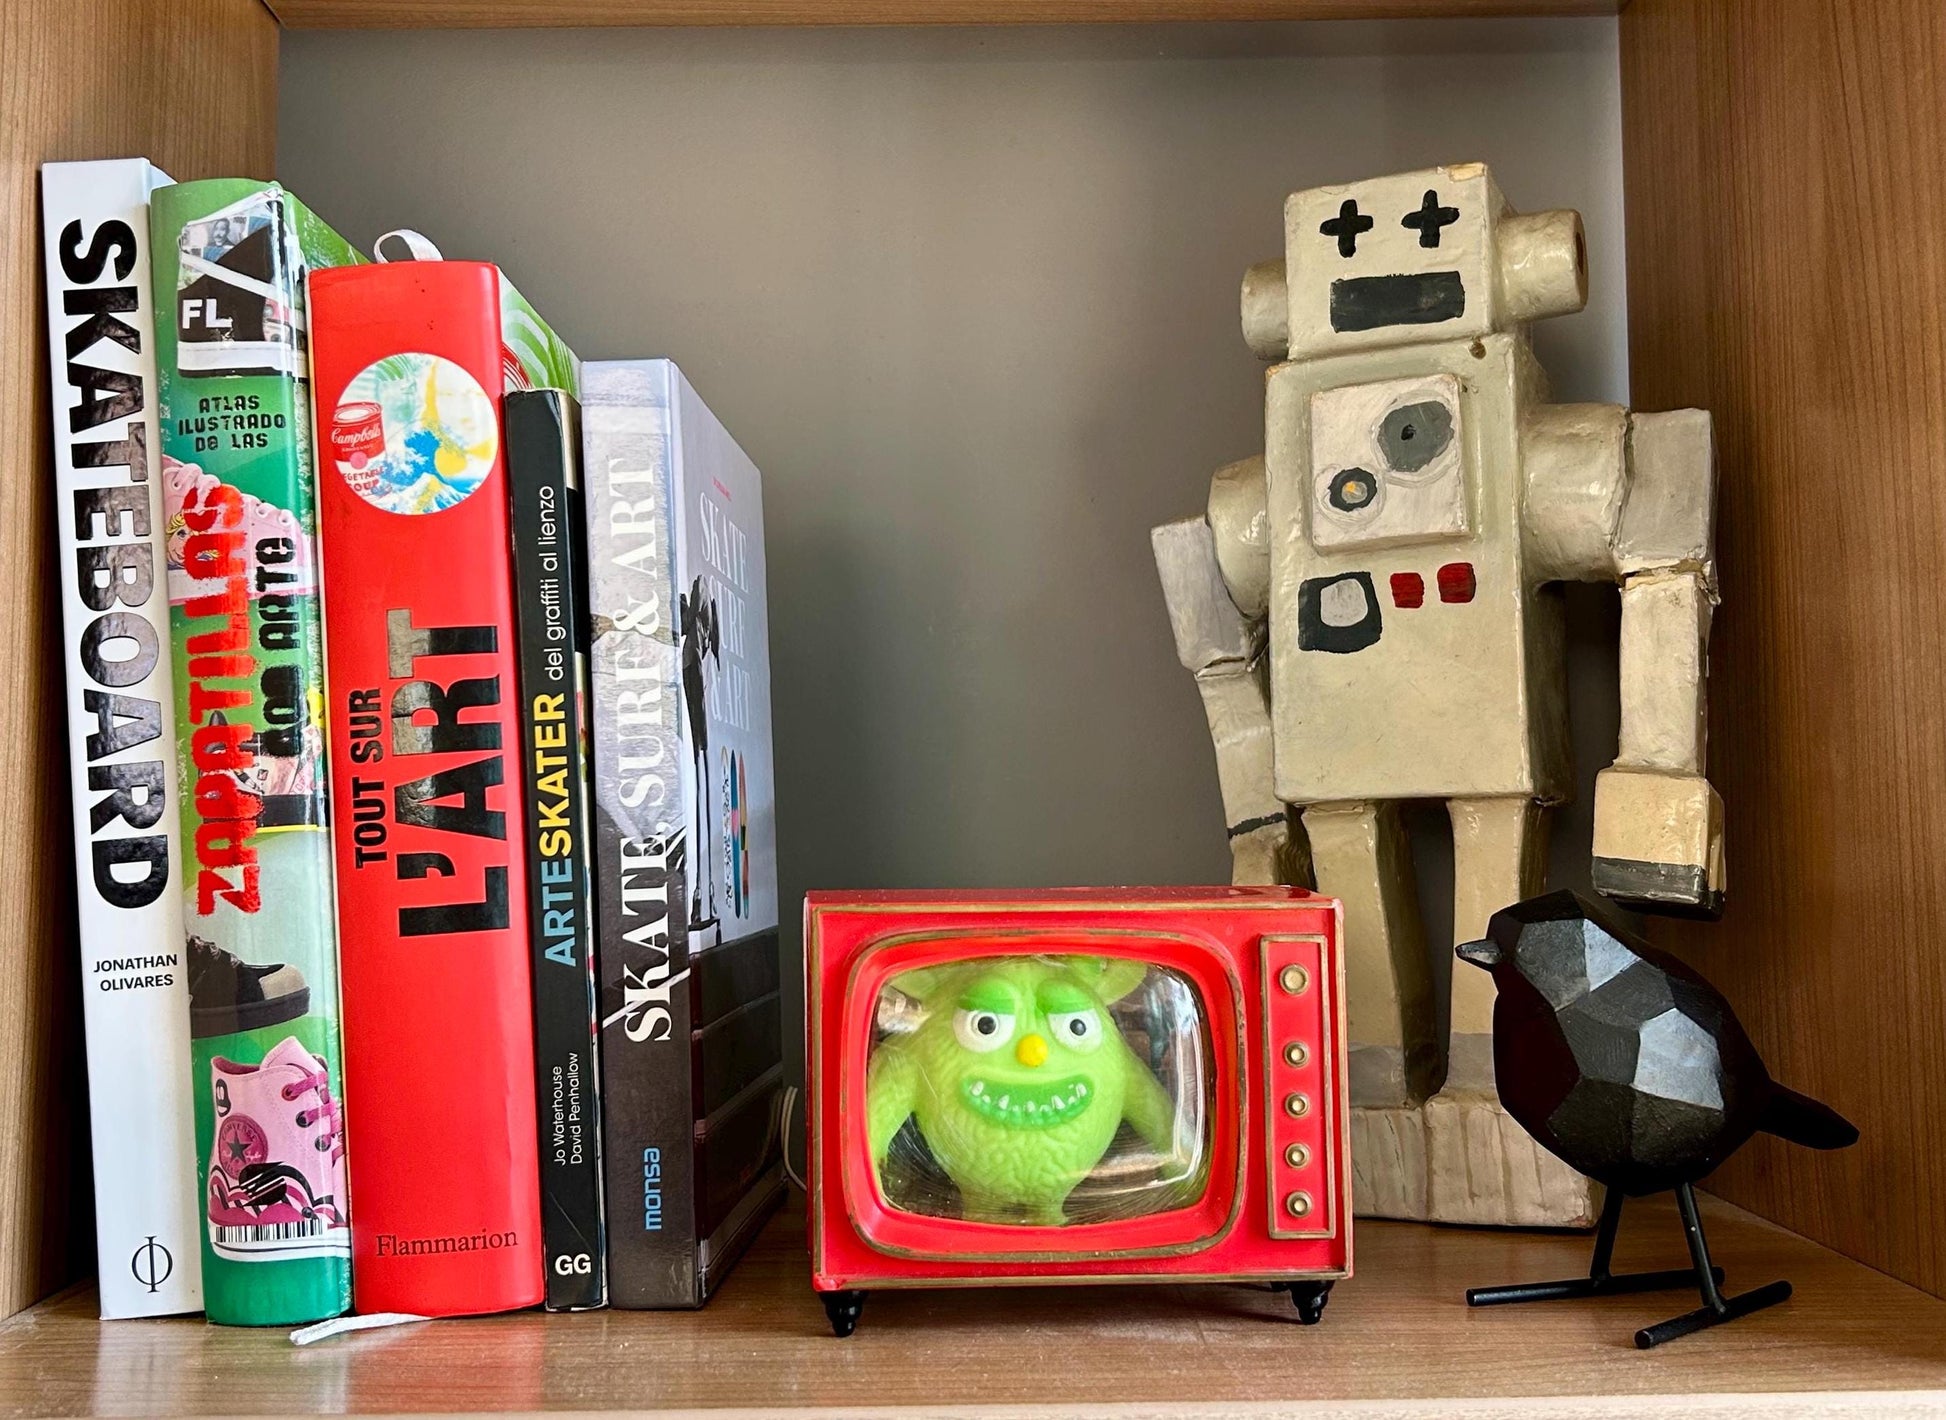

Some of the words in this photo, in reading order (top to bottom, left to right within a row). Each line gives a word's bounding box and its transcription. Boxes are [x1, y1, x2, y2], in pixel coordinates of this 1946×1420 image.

[182, 298, 232, 329] FL
[178, 413, 286, 436] ILUSTRADO
[199, 395, 260, 413] ATLAS
[232, 432, 268, 449] LAS
[350, 479, 379, 493] OUP
[538, 485, 557, 545] lienzo
[609, 458, 658, 580] ART
[700, 491, 749, 594] SKATE
[59, 219, 169, 908] SKATEBOARD
[539, 552, 559, 571] al
[540, 578, 566, 641] graffiti
[612, 590, 660, 635] &
[544, 647, 565, 681] del
[183, 484, 264, 915] ZAPATILLAS
[349, 687, 384, 764] SUR
[615, 650, 666, 808] SURF
[386, 608, 510, 937] L'ART
[351, 777, 387, 870] TOUT
[533, 693, 576, 967] ARTESKATER
[620, 822, 672, 1042] SKATE,
[93, 954, 177, 973] JONATHAN
[100, 974, 174, 991] OLIVARES
[552, 1066, 565, 1147] Waterhouse
[567, 1052, 580, 1122] Penhallow
[553, 1149, 566, 1166] Jo
[569, 1125, 583, 1164] David
[643, 1147, 662, 1230] monsa
[375, 1228, 518, 1256] Flammarion
[554, 1253, 592, 1275] GG
